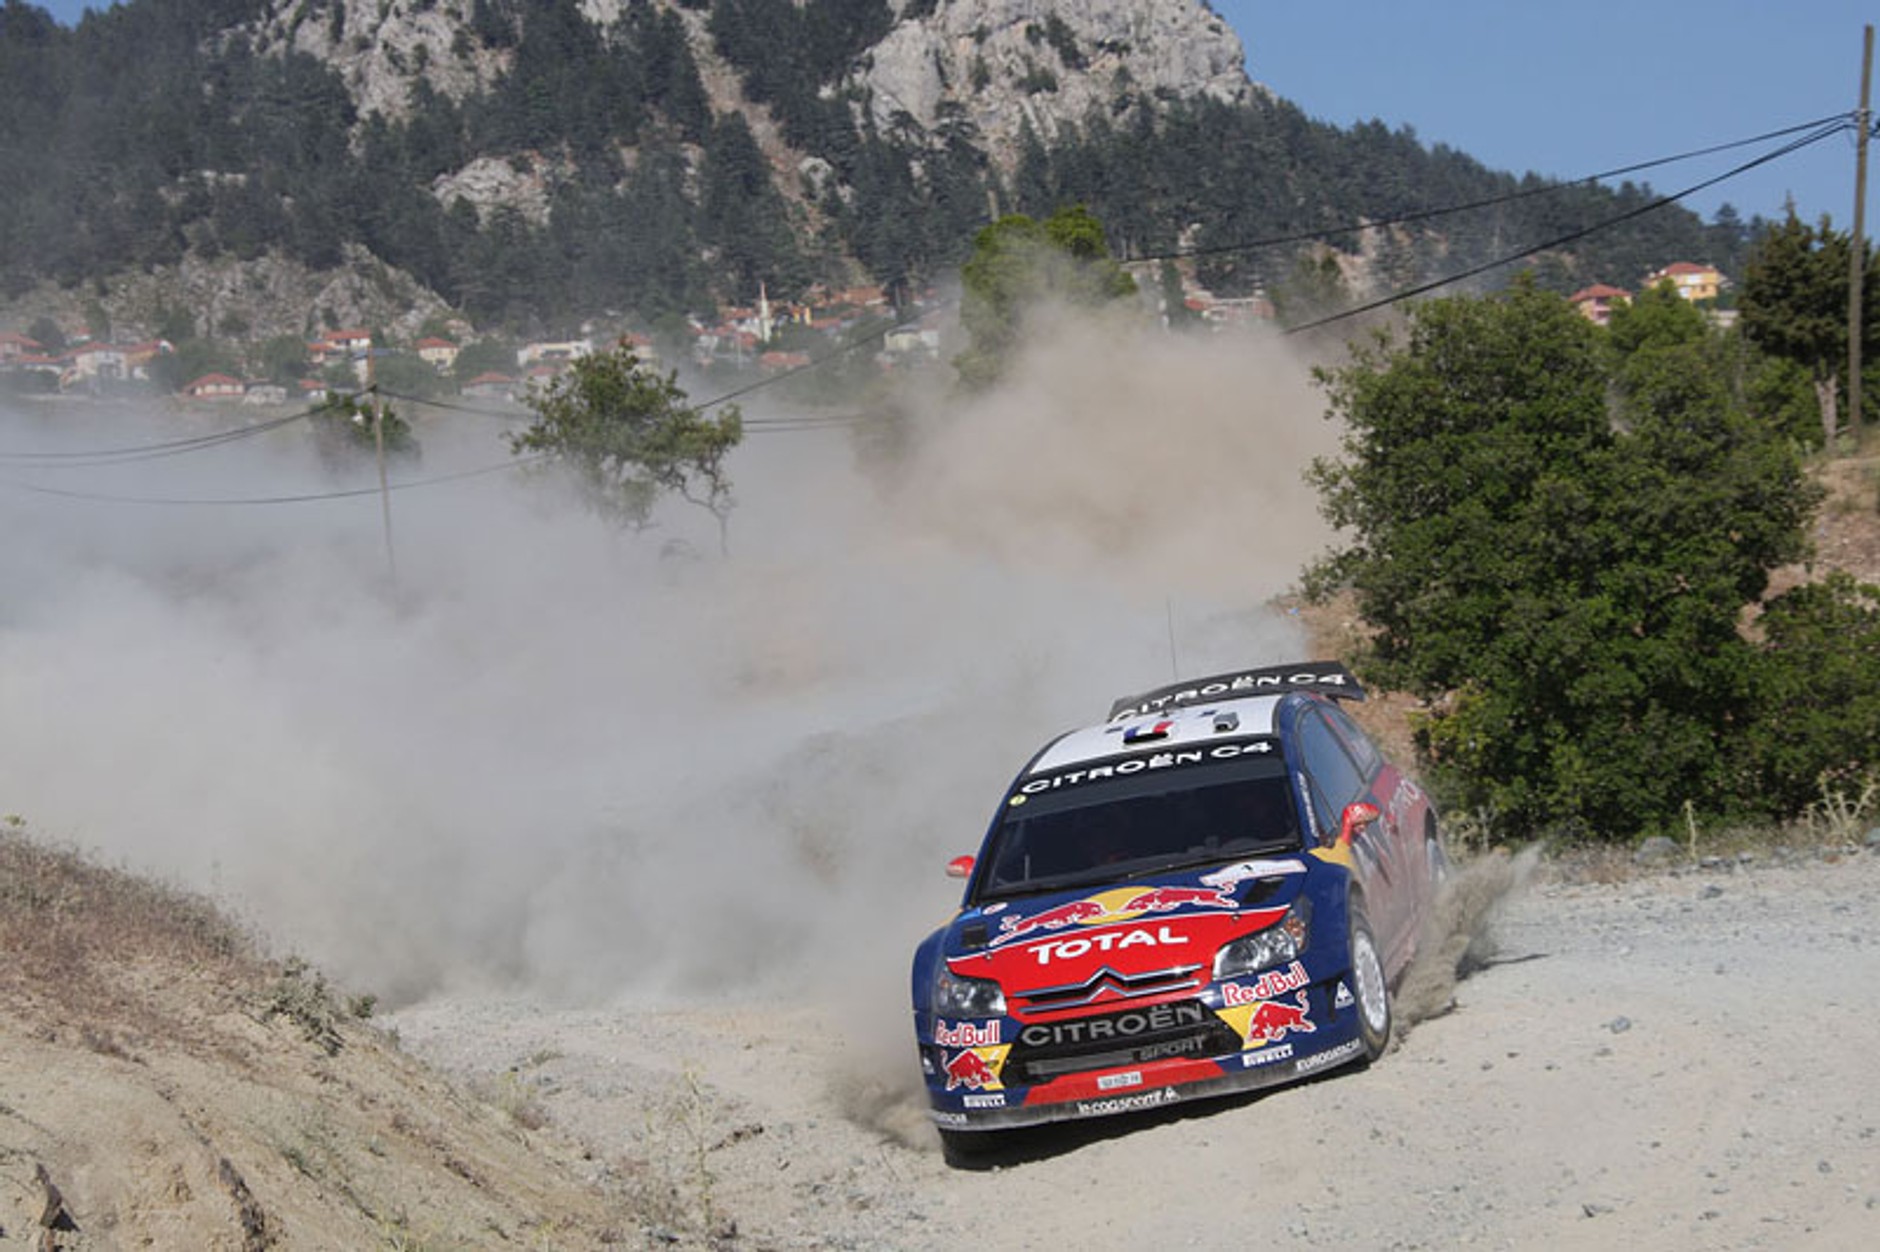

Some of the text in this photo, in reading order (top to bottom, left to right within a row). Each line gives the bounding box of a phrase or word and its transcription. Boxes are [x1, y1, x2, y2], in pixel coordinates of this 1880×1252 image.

[1288, 673, 1346, 686] C4
[1021, 740, 1273, 793] CITROËN C4
[1027, 926, 1189, 965] TOTAL
[1021, 1003, 1203, 1047] CITROËN
